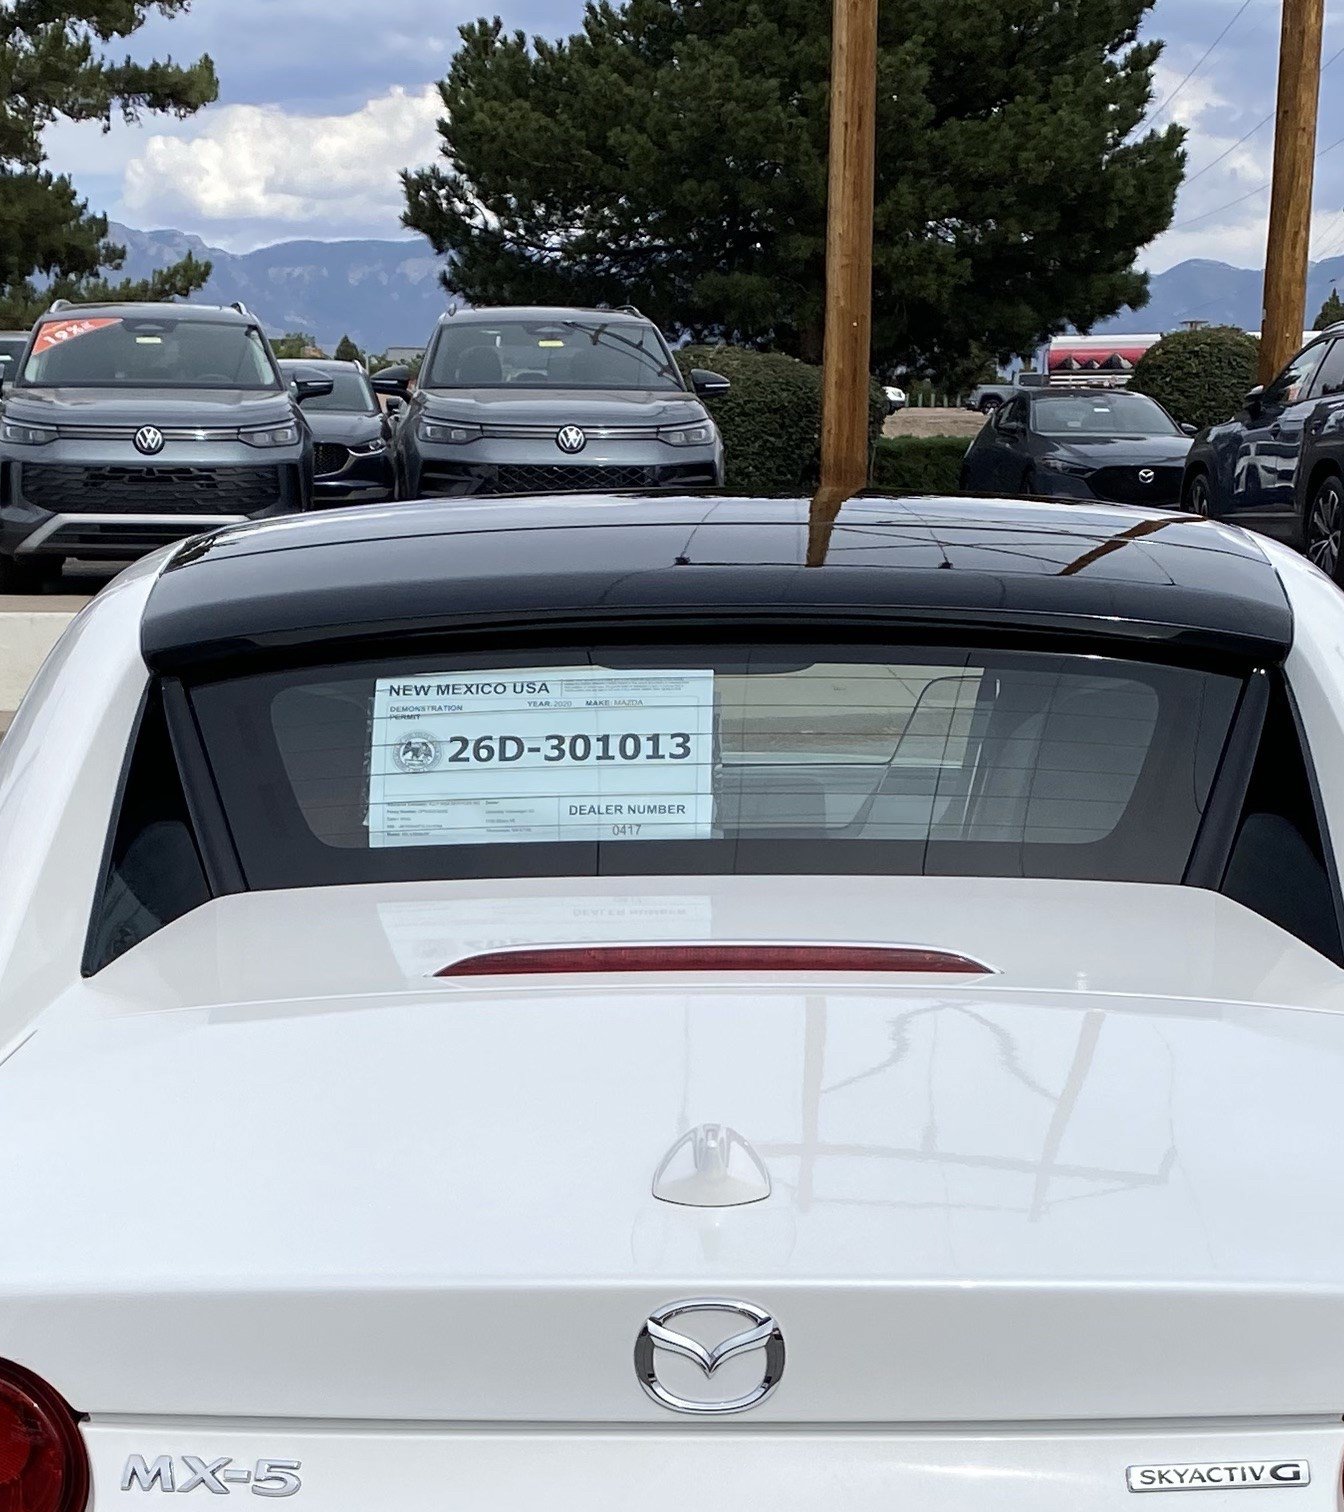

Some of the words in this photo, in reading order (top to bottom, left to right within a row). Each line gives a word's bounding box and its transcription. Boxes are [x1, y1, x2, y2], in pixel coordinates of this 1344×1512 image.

[388, 684, 432, 697] NEW
[436, 682, 507, 696] MEXICO
[512, 682, 550, 695] USA
[389, 704, 463, 713] DEMONSTRATION
[613, 699, 644, 707] MAZDA
[389, 713, 421, 721] PERMIT
[447, 732, 692, 764] 26D-301013
[568, 804, 624, 816] DEALER
[627, 804, 686, 815] NUMBER
[612, 823, 642, 836] 0417
[120, 1453, 302, 1498] MX-5
